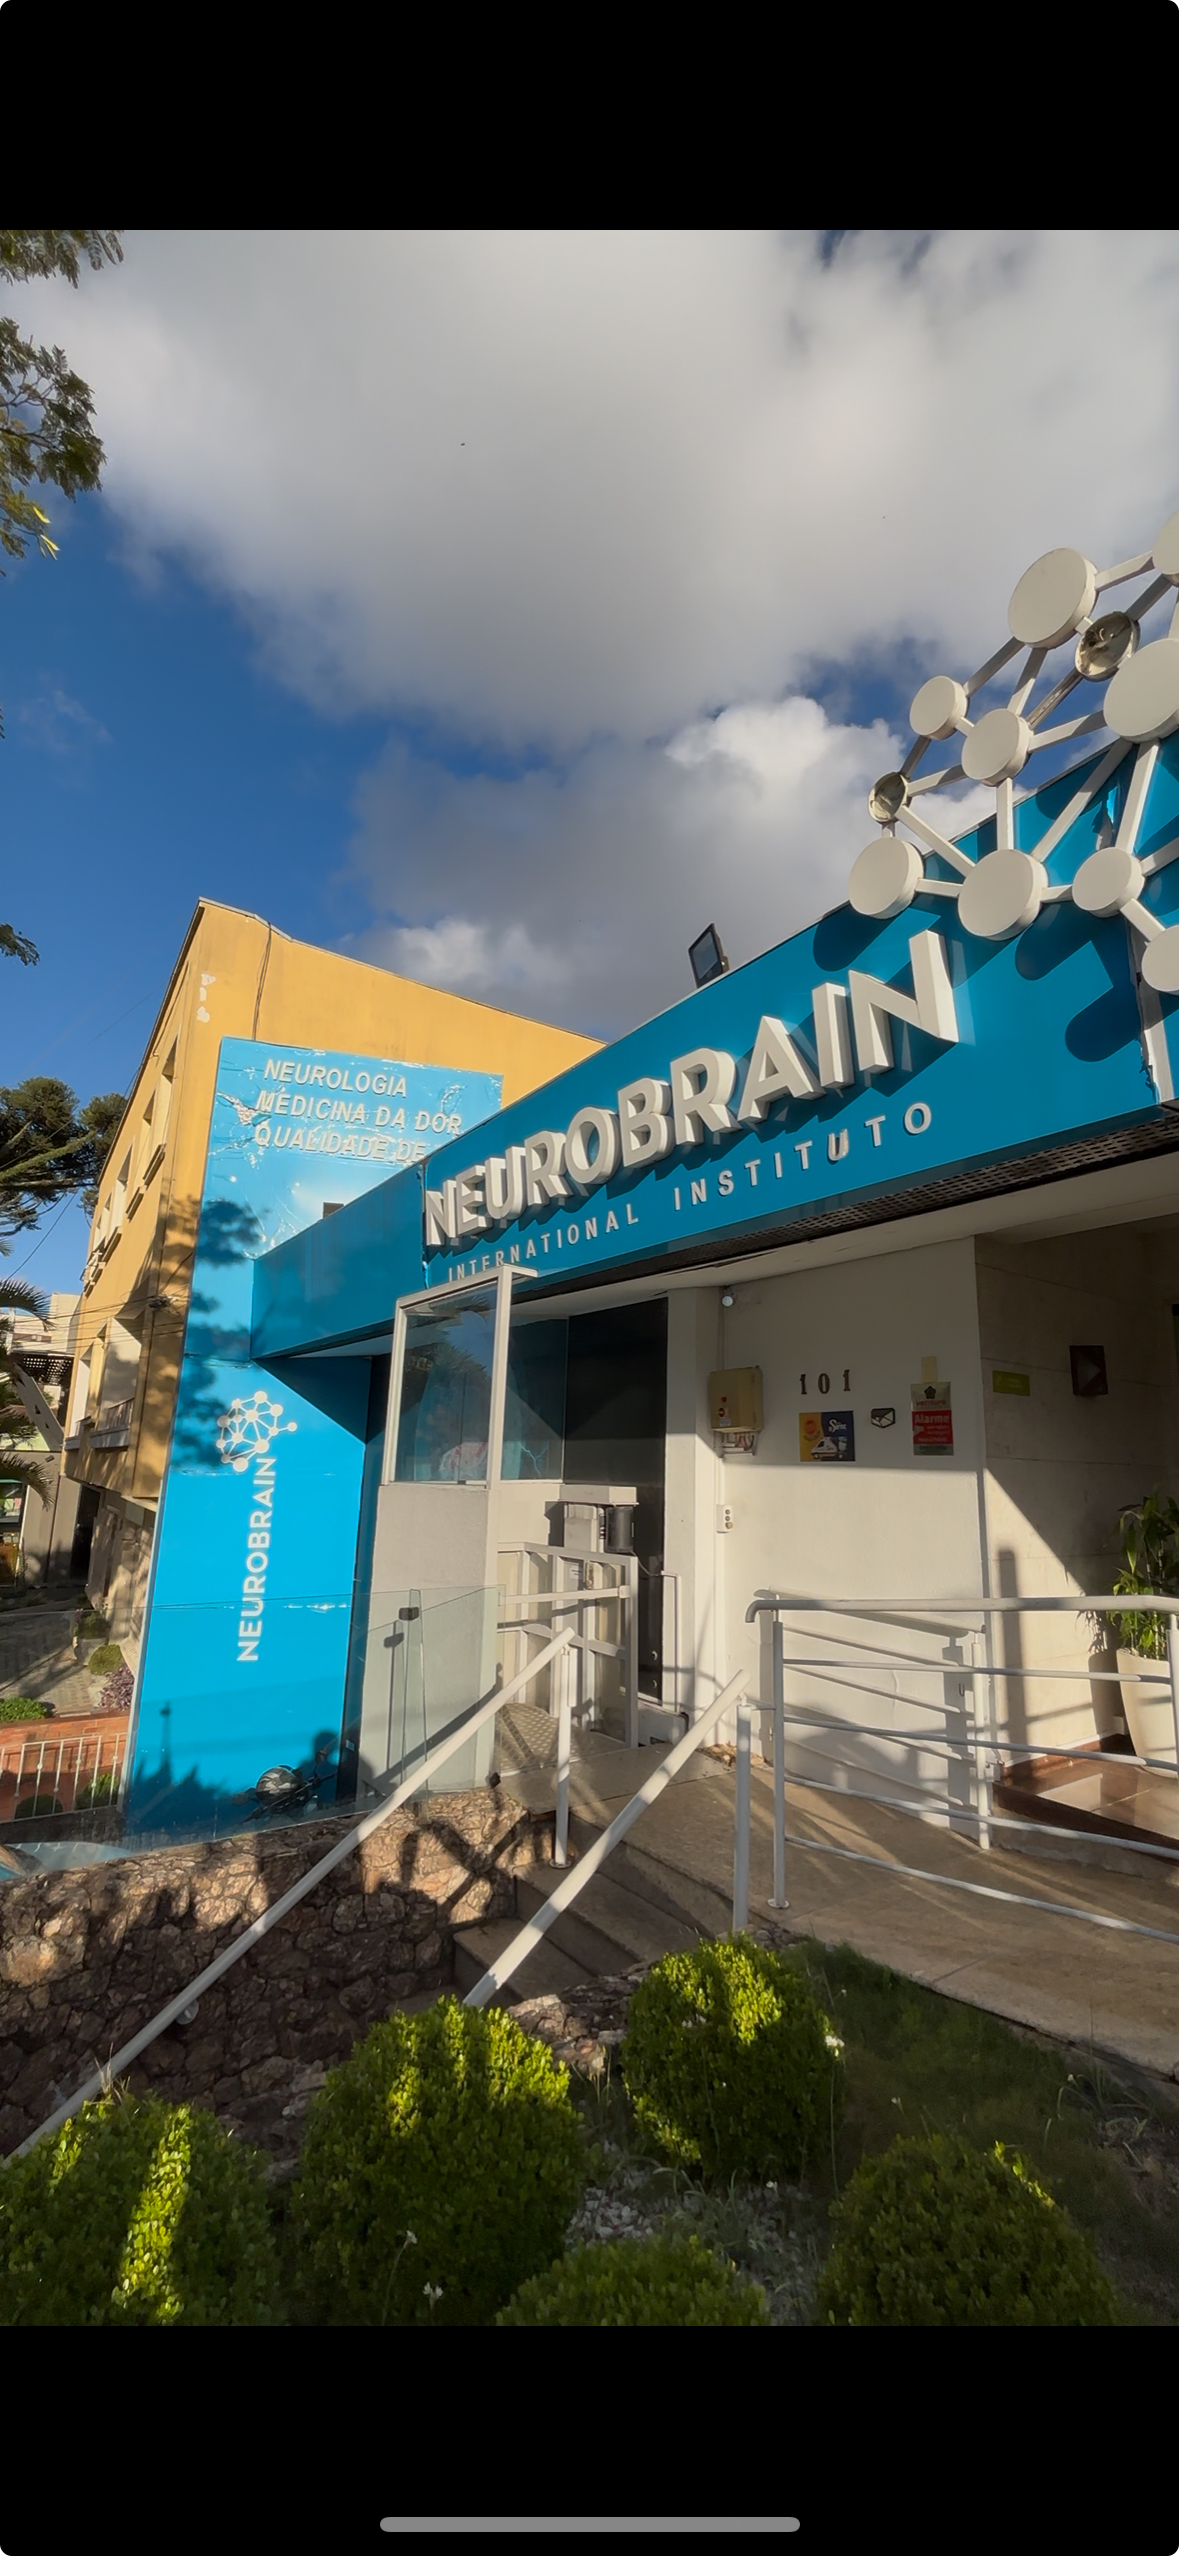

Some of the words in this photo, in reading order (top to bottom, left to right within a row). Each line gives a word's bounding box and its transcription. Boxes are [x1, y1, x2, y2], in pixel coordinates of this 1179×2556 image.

[263, 1058, 407, 1098] NEUROLOGIA
[425, 929, 960, 1247] NEUROBRAIN
[255, 1090, 365, 1126] MEDICINA
[375, 1106, 406, 1129] DA
[415, 1111, 463, 1137] DOR
[254, 1124, 390, 1160] QUALIDADE
[396, 1140, 427, 1163] DE
[448, 1203, 639, 1283] INTERNATIONAL
[673, 1102, 933, 1211] INSTITUTO
[799, 1369, 851, 1395] 101
[914, 1413, 950, 1424] Alarme
[237, 1456, 277, 1663] NEUROBRAIN
